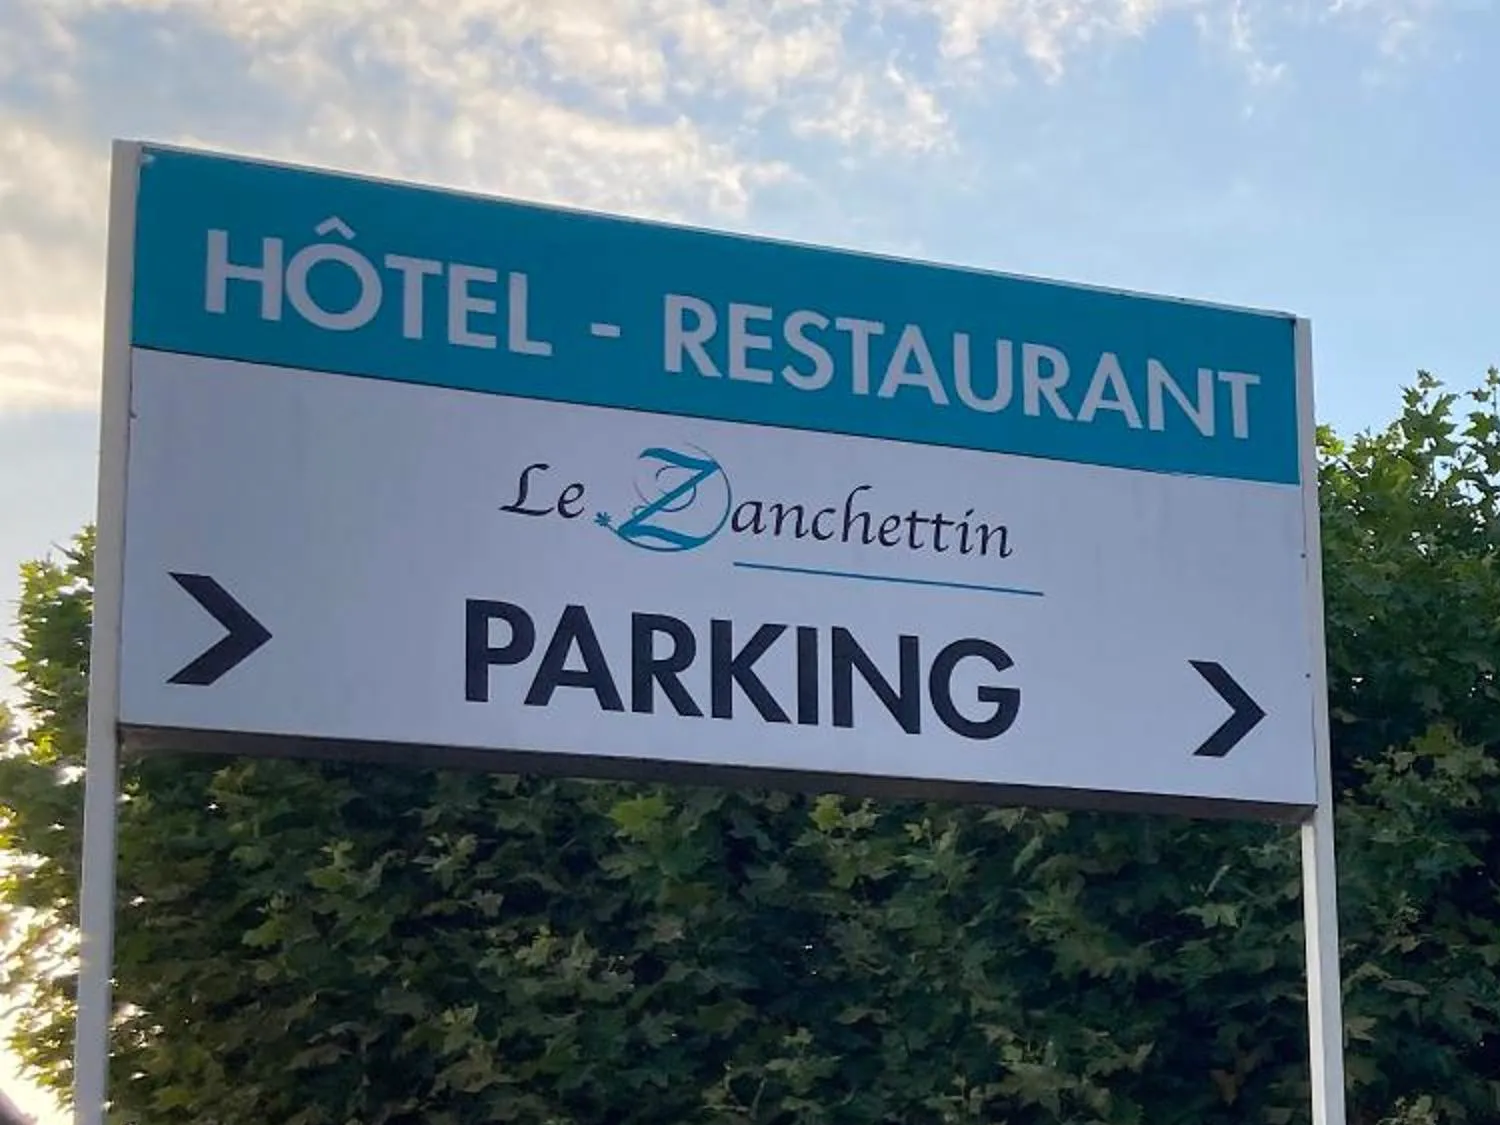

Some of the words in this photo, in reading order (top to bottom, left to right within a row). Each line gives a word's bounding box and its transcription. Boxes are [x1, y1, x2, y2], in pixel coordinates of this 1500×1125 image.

[204, 216, 552, 358] HÔTEL
[662, 293, 1262, 441] RESTAURANT
[498, 462, 585, 518] Le
[598, 443, 1014, 560] Zanchettin
[464, 599, 1021, 741] PARKING
